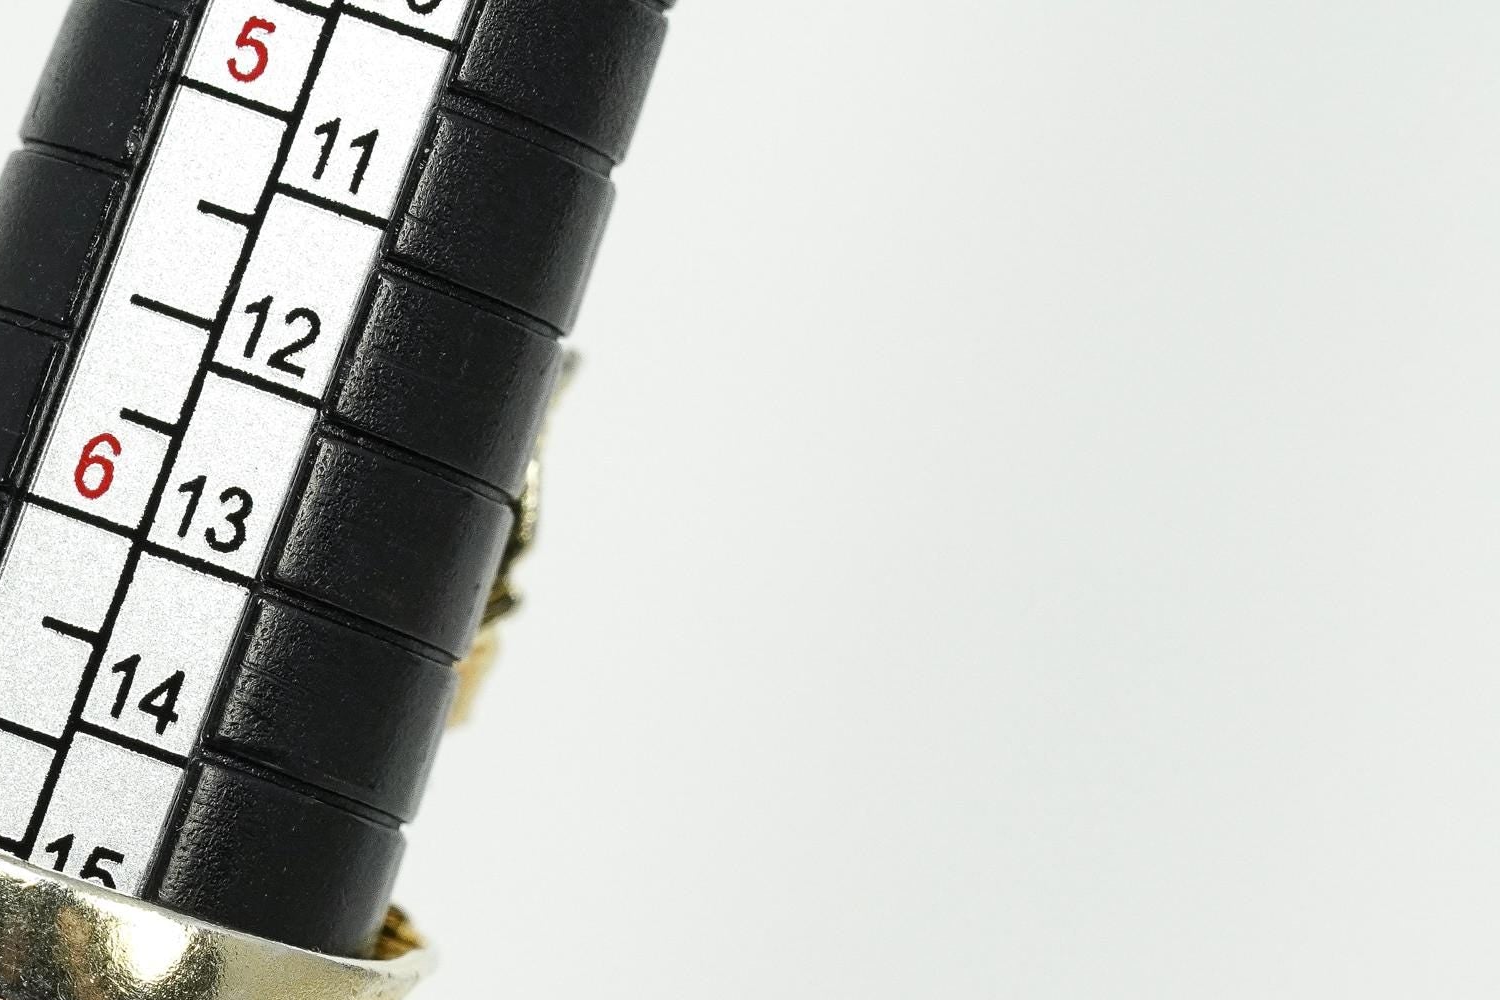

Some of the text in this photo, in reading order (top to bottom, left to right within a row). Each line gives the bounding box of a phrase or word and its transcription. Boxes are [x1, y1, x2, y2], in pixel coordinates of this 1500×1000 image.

[227, 16, 276, 83] 5
[313, 117, 379, 195] 11
[243, 295, 322, 379] 12
[74, 433, 122, 500] 6
[177, 475, 254, 554] 13
[110, 653, 186, 736] 14
